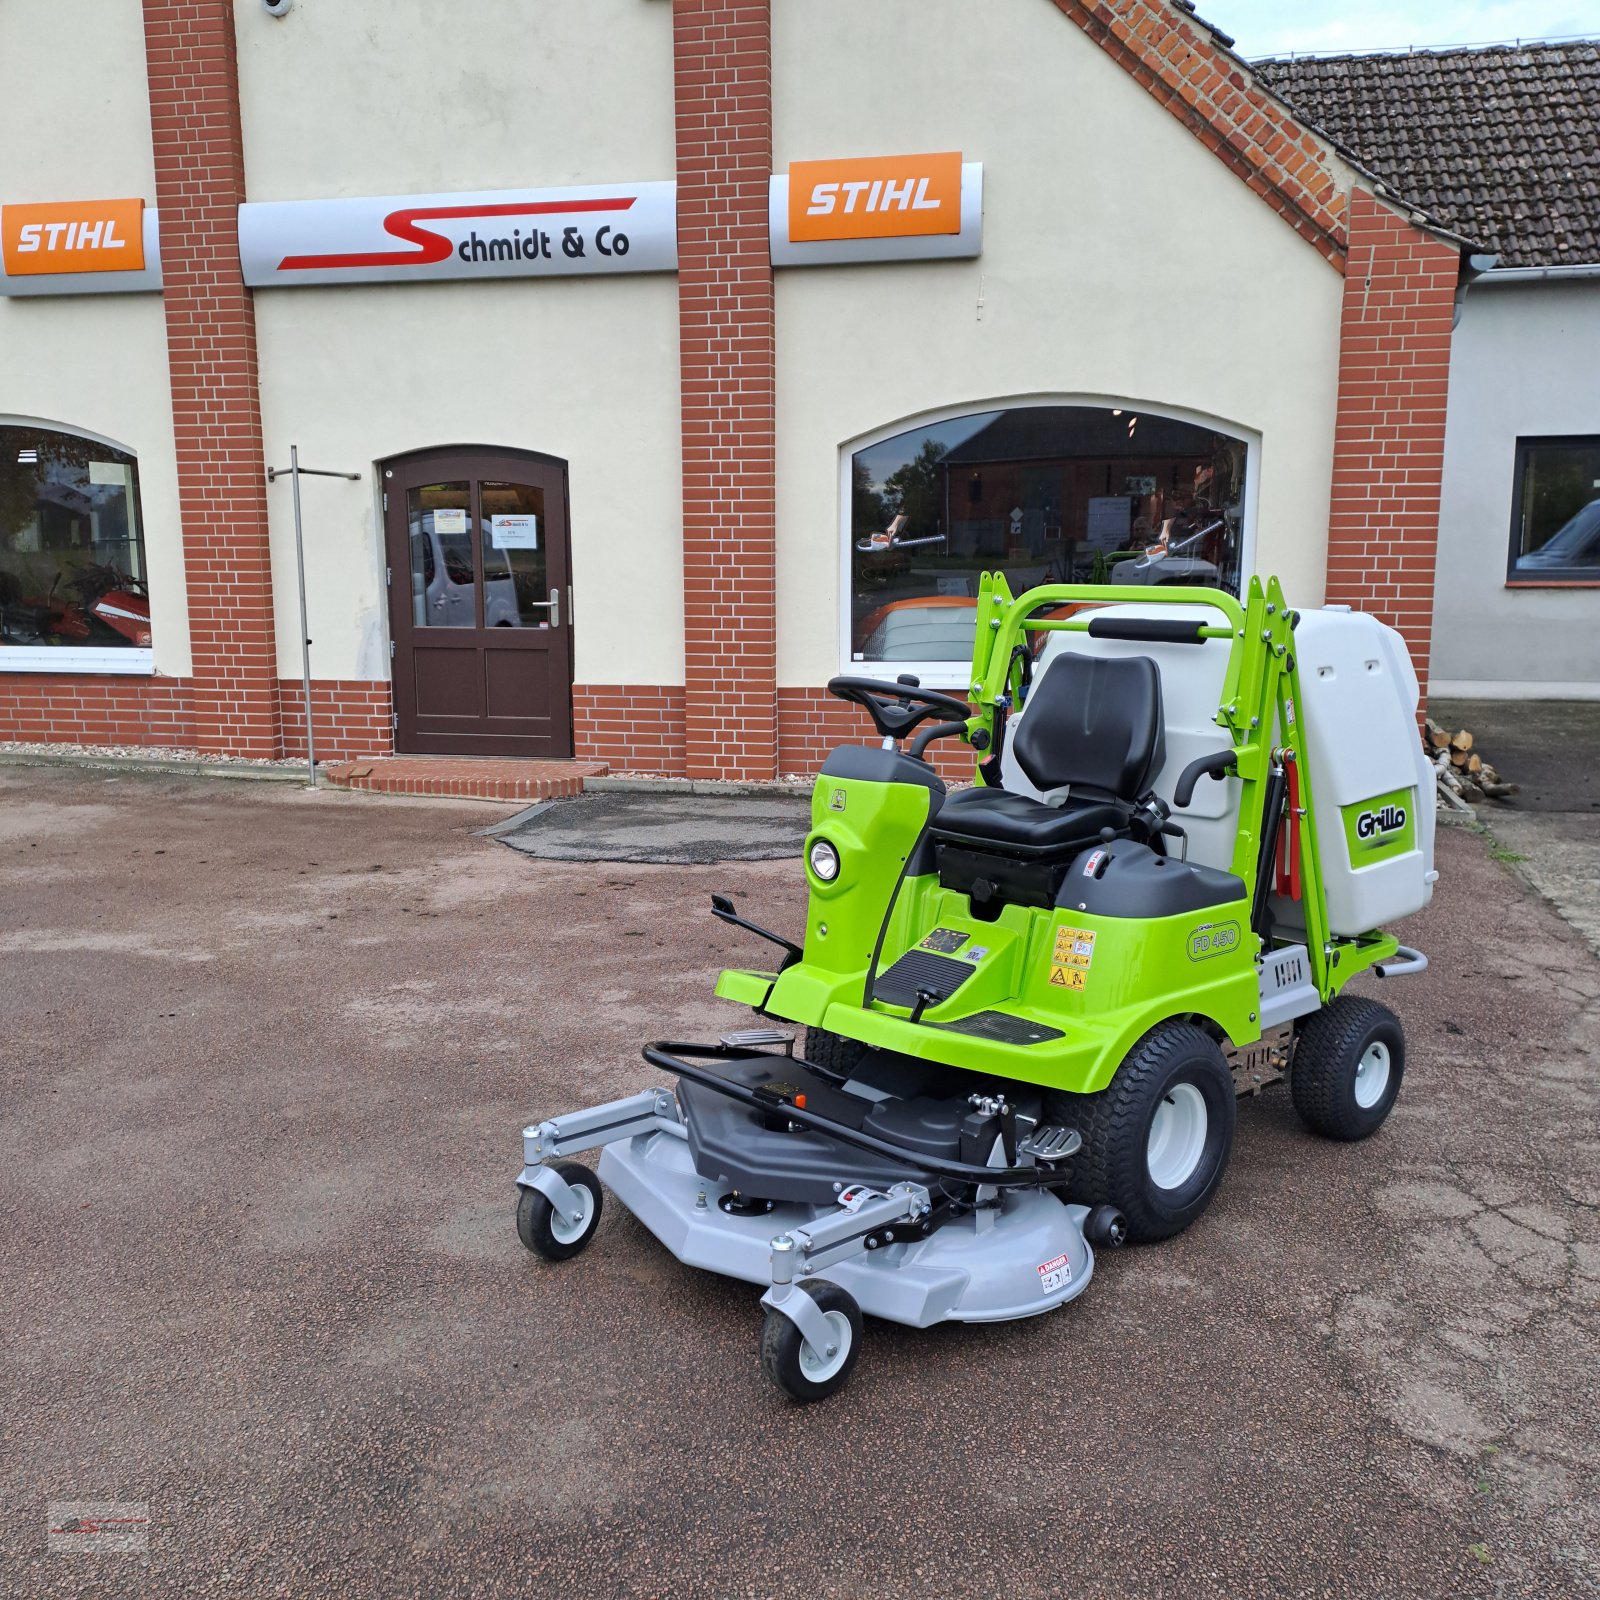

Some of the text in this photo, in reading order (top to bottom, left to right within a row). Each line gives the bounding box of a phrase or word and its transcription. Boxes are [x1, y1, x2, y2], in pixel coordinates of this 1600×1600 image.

[806, 178, 941, 215] STIHL
[17, 220, 125, 252] STIHL
[383, 204, 630, 267] Schmidt & Co
[1357, 806, 1406, 839] Grillo
[1193, 929, 1235, 954] FD 450
[1045, 1256, 1067, 1272] DANGER
